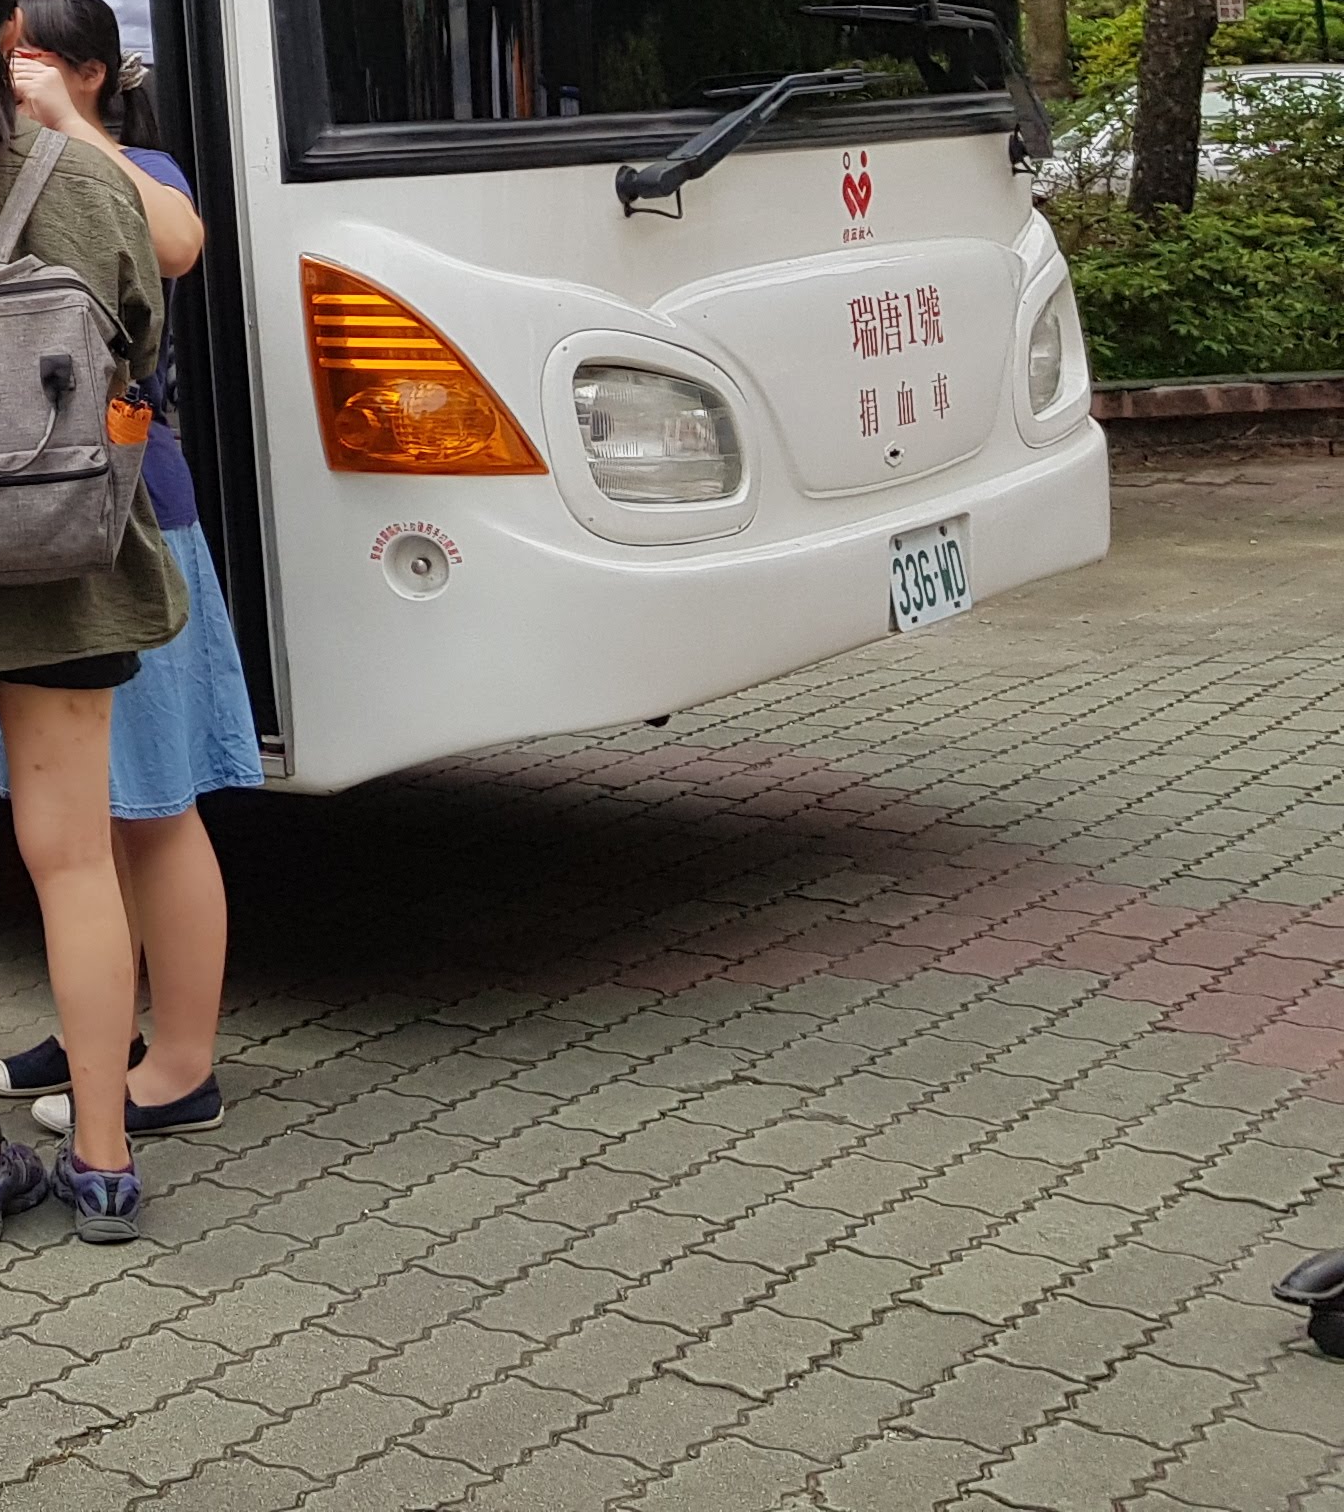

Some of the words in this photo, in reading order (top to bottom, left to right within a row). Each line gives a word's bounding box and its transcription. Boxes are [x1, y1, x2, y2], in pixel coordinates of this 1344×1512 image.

[847, 284, 944, 360] 瑞唐1號
[858, 373, 951, 437] 捐血車
[892, 539, 966, 616] 336-WD
